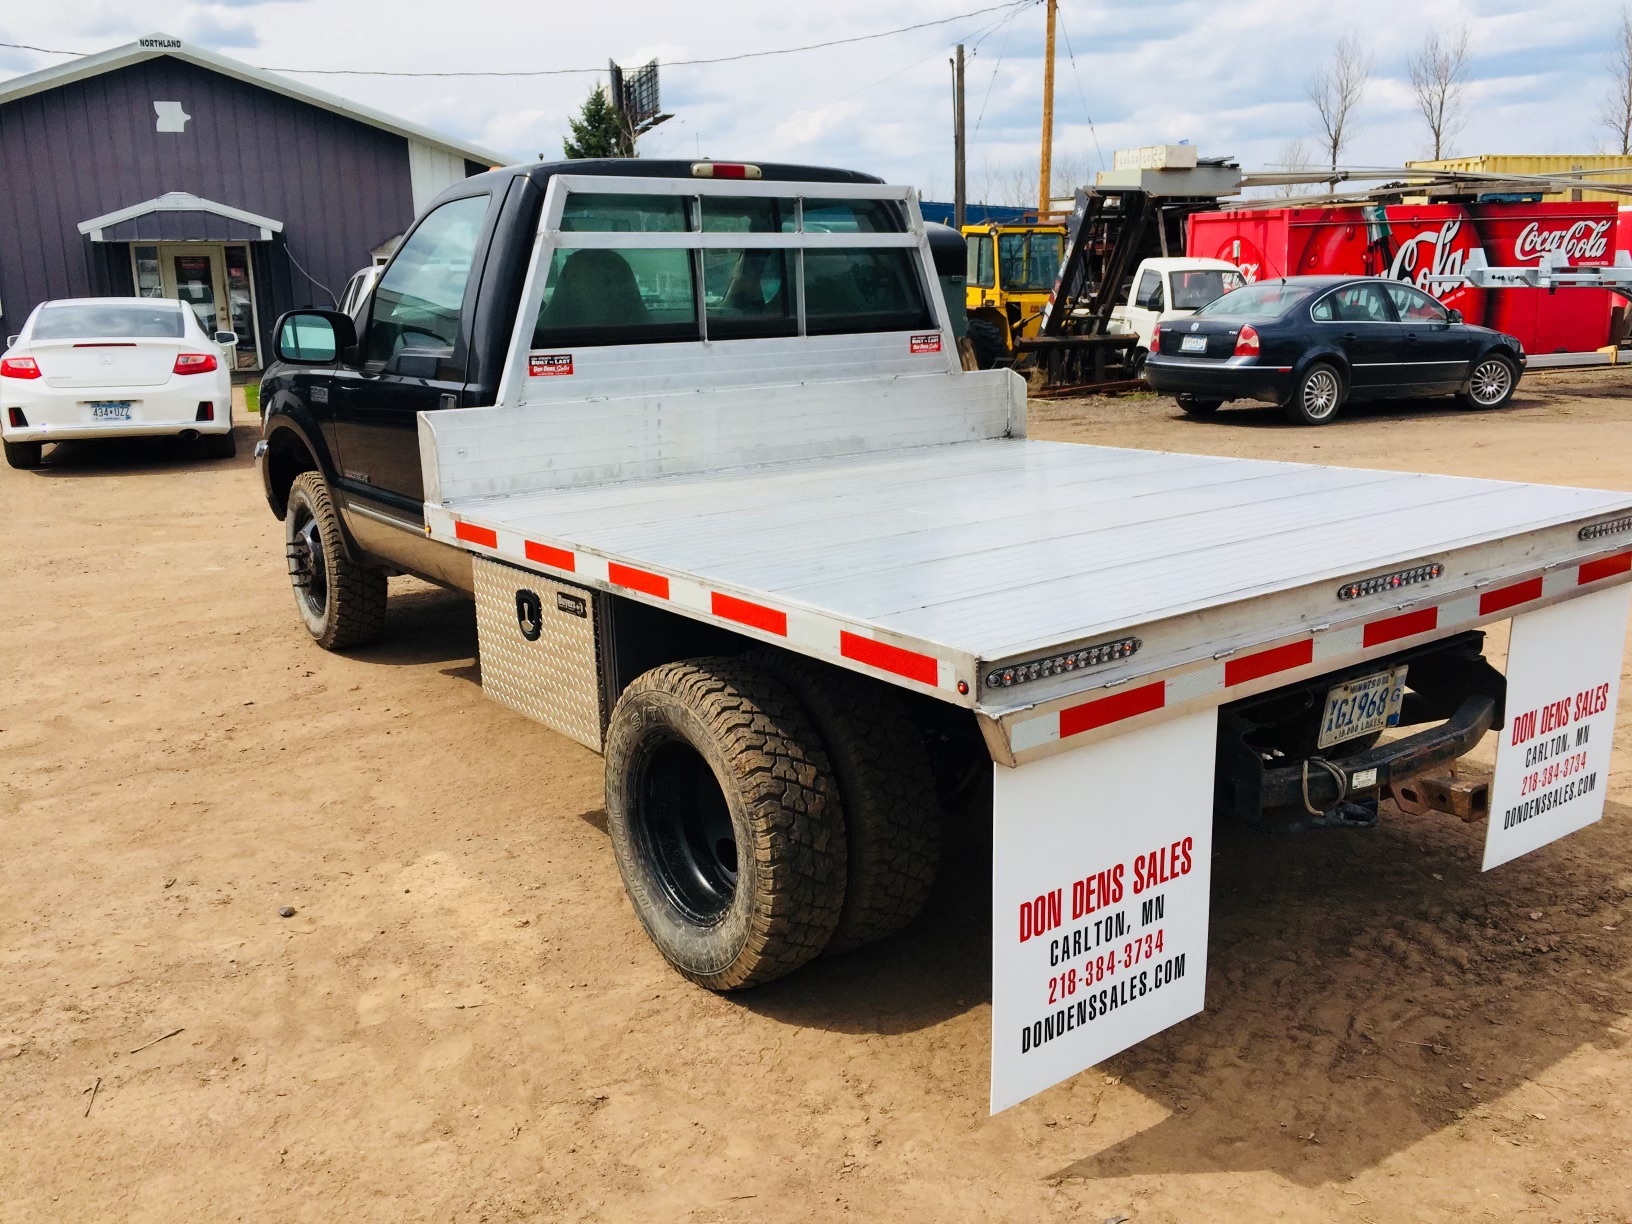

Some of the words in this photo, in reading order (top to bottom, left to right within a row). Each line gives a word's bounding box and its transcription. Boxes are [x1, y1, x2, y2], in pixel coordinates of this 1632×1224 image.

[140, 39, 181, 48] NORTHLAND
[1514, 220, 1612, 261] Coca-Cola
[1361, 717, 1382, 731] LAKES
[1512, 709, 1537, 746] DON
[1540, 697, 1571, 734] DENS
[1574, 683, 1609, 722] SALES
[1521, 751, 1587, 796] 218-384-3734
[1525, 733, 1570, 768] CARLTON,
[1575, 725, 1590, 747] MN
[1504, 772, 1596, 830] DONDENSSALES.COM
[1019, 888, 1062, 943] DON
[1072, 863, 1124, 920] DENS
[1133, 836, 1193, 894] SALES
[1050, 911, 1131, 967] CARLTON,
[1141, 894, 1165, 926] MN
[1048, 929, 1163, 1005] 218-384-3734
[1022, 953, 1186, 1054] DONDENSSALES.COM
